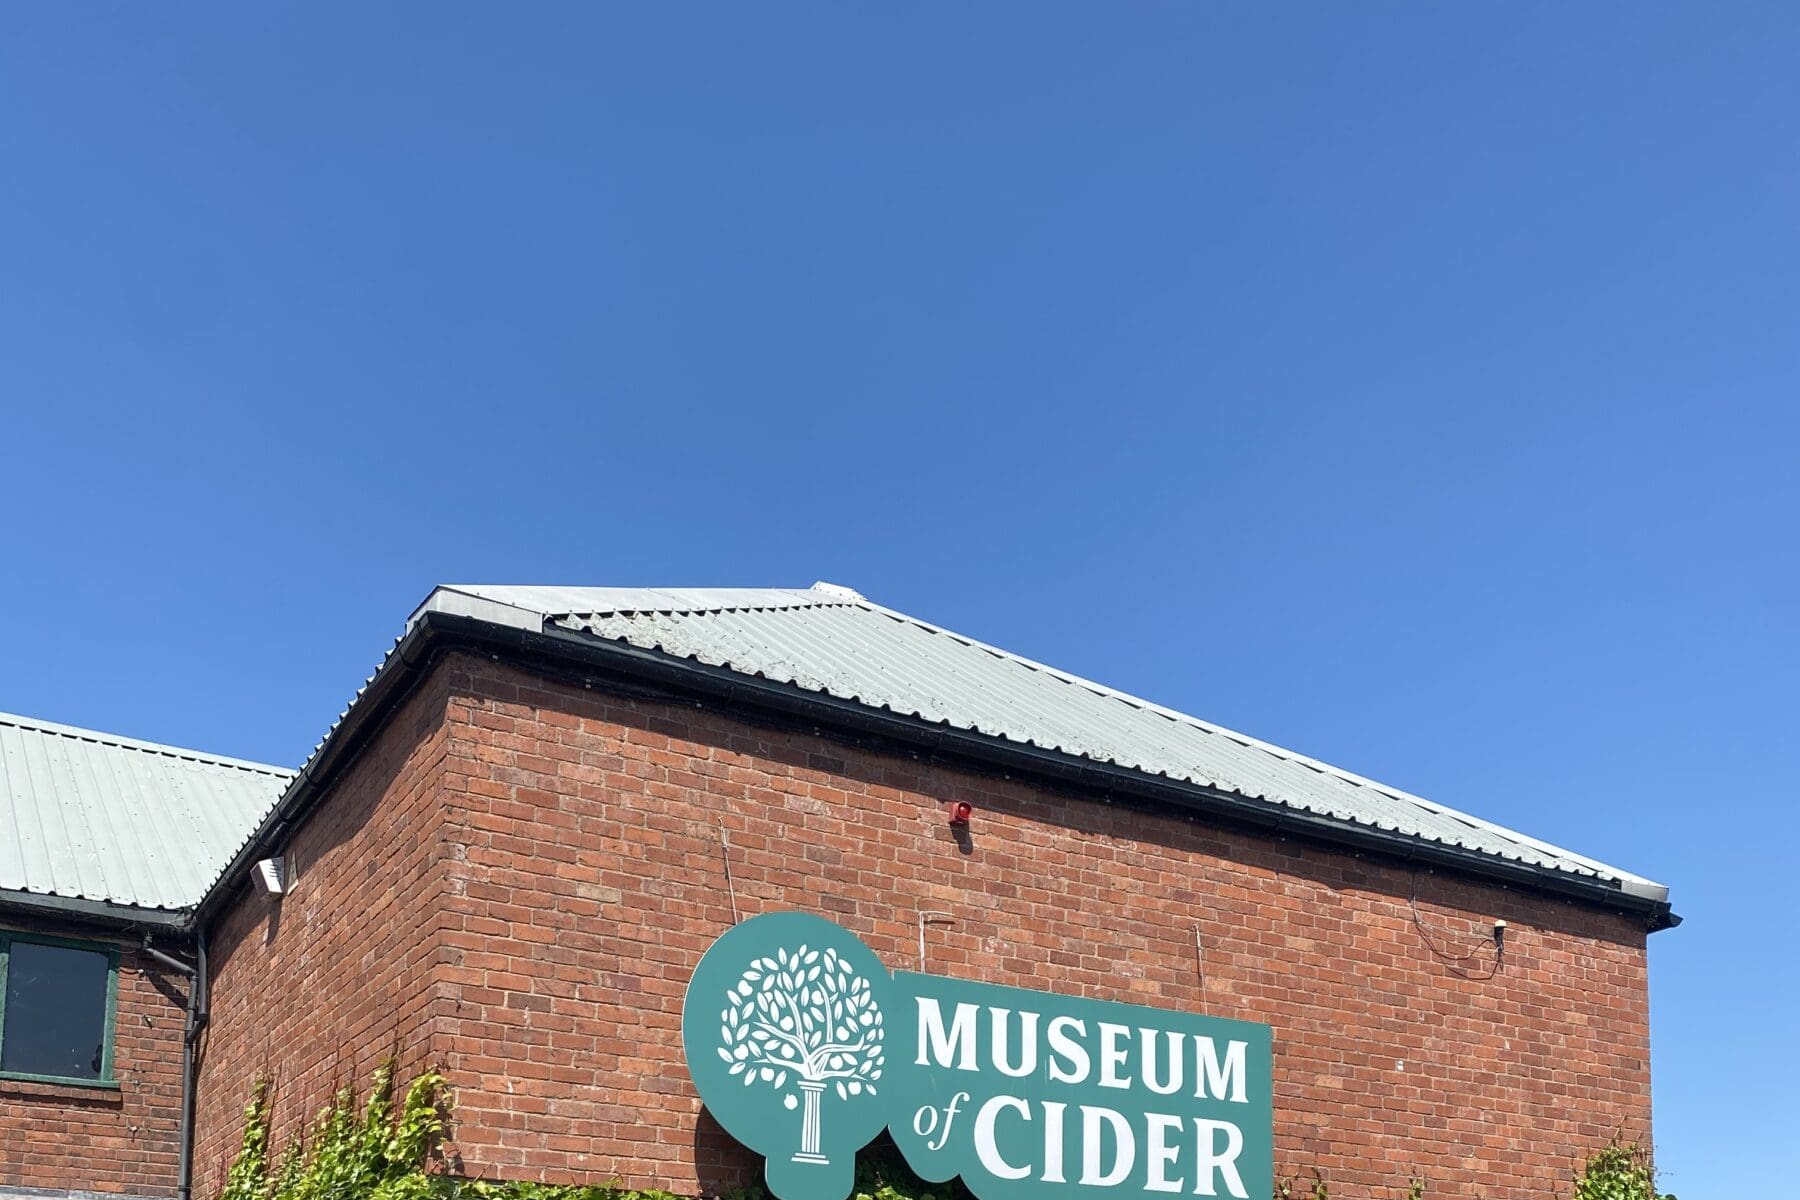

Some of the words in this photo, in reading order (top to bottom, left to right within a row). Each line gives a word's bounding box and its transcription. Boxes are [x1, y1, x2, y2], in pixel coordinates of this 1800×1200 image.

[914, 995, 1249, 1104] MUSEUM
[913, 1092, 970, 1151] of
[973, 1095, 1250, 1199] CIDER
